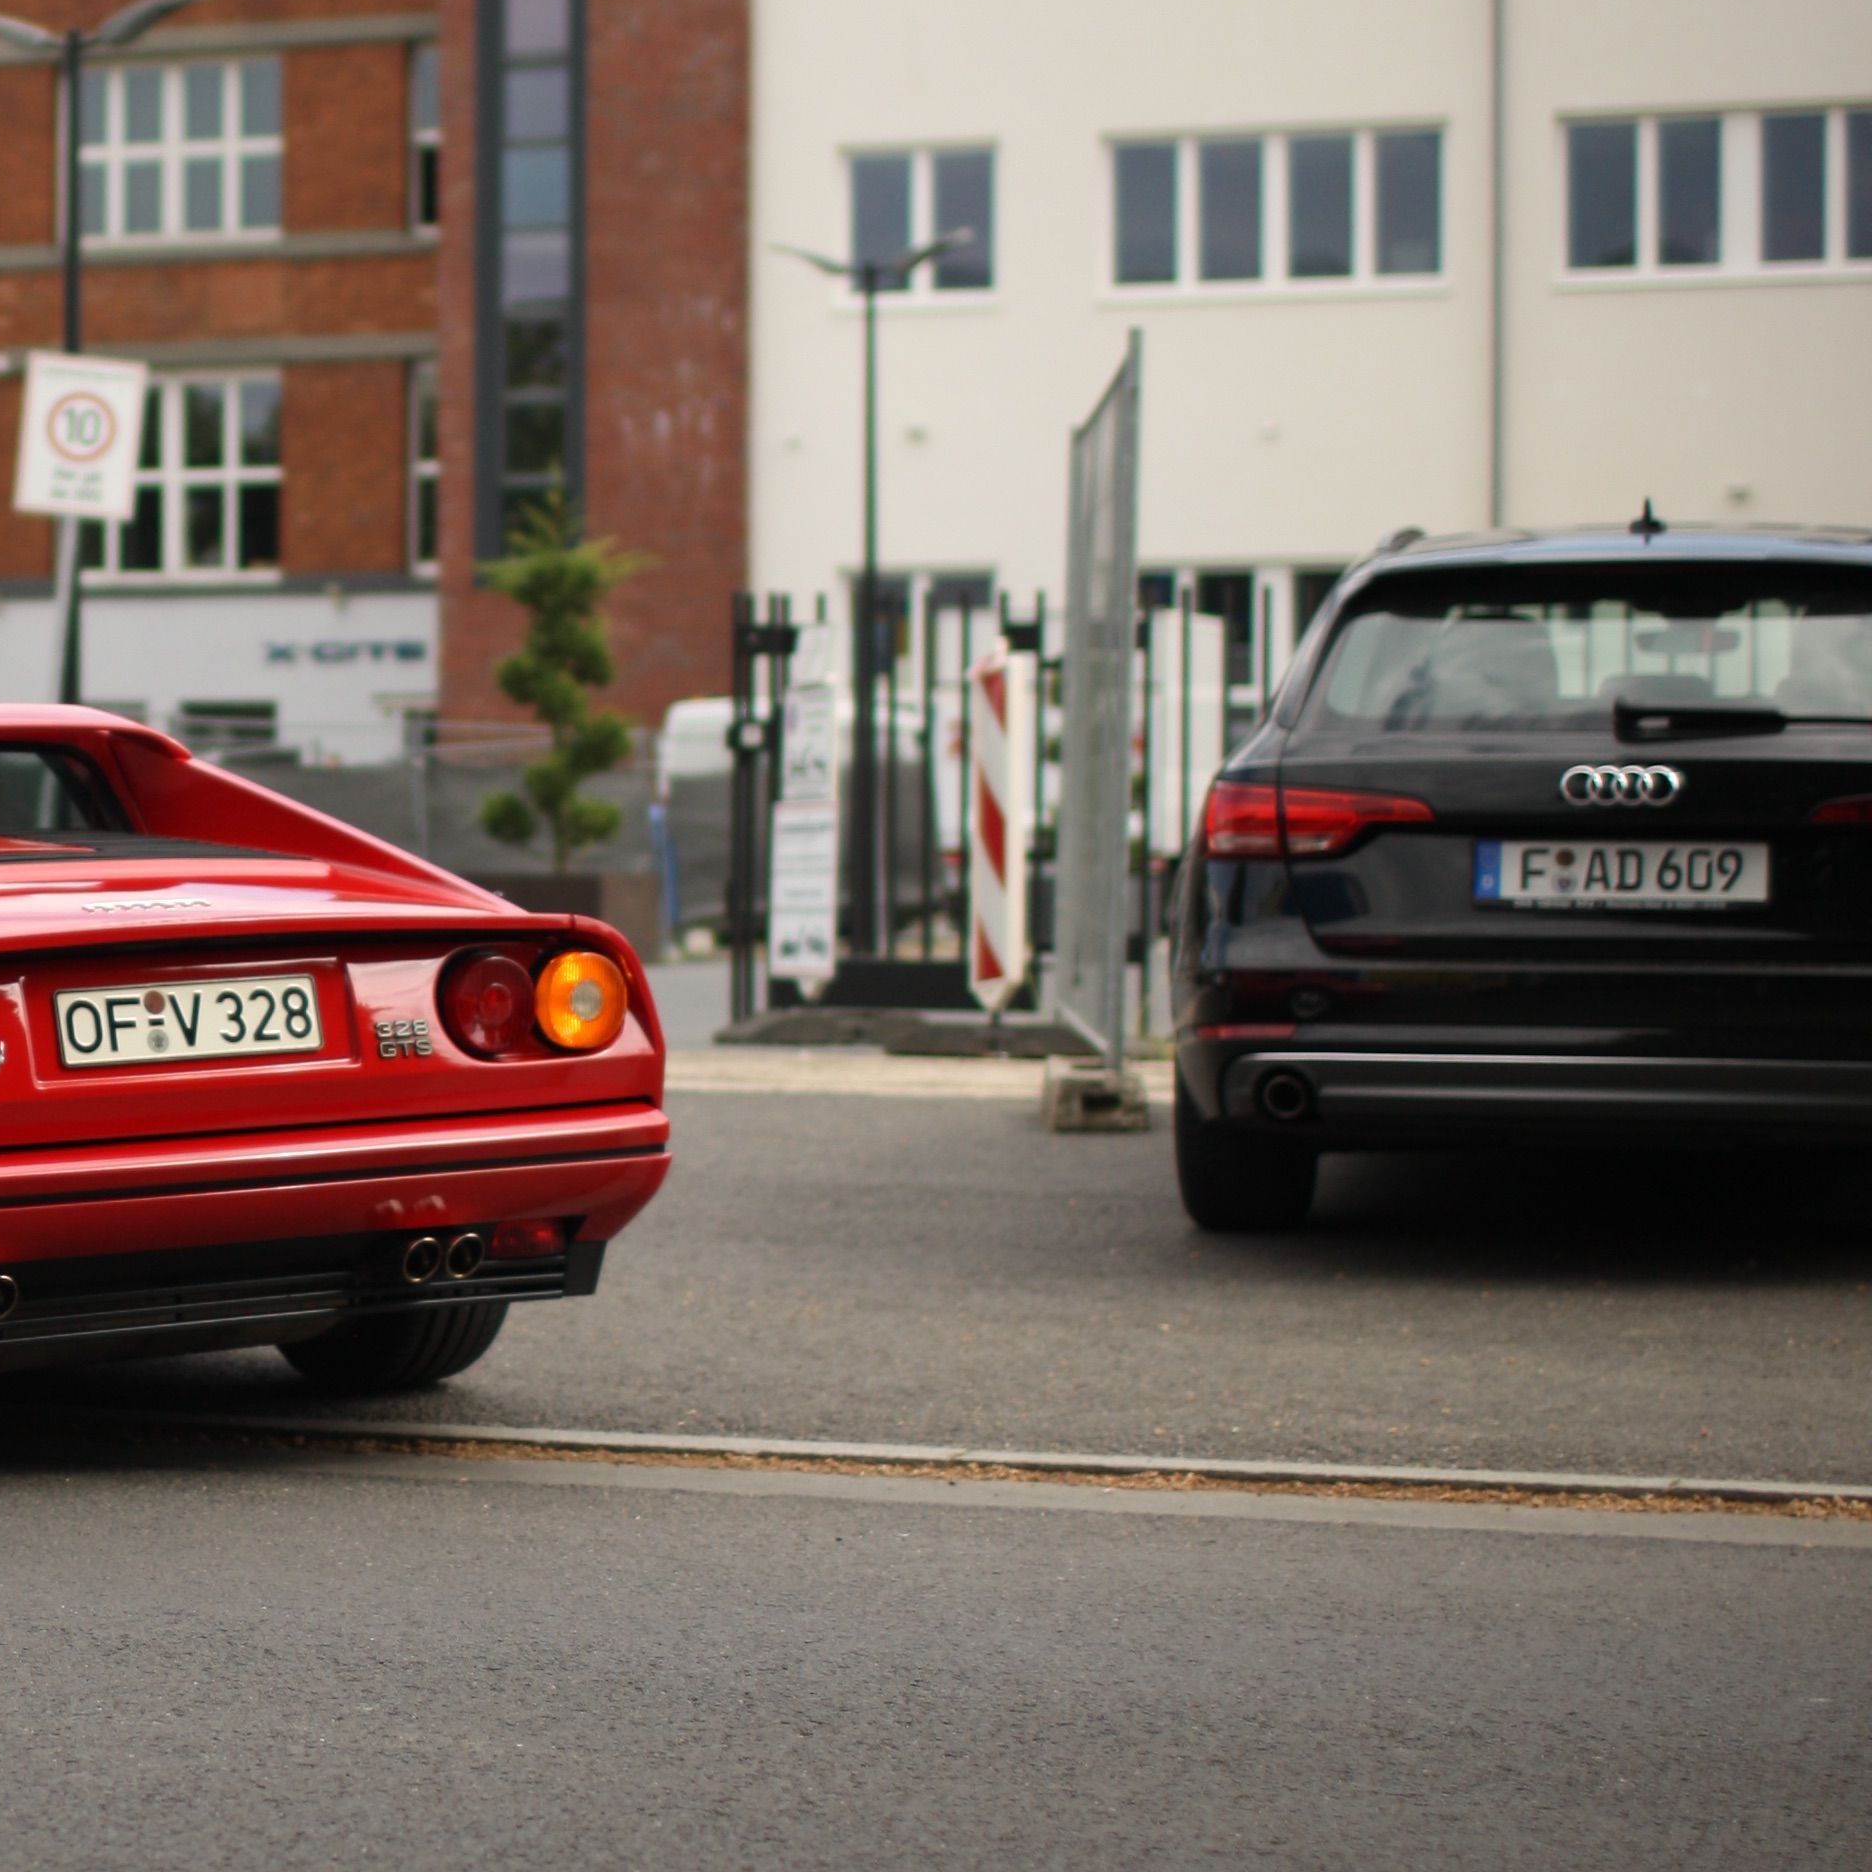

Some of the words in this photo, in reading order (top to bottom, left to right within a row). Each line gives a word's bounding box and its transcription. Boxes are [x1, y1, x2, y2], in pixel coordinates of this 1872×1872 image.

[65, 408, 102, 446] 10
[1521, 848, 1549, 890] F
[1584, 848, 1645, 891] AD
[1657, 848, 1743, 891] 609
[216, 986, 312, 1043] 328
[376, 1019, 429, 1038] 328
[380, 1039, 433, 1058] GTS
